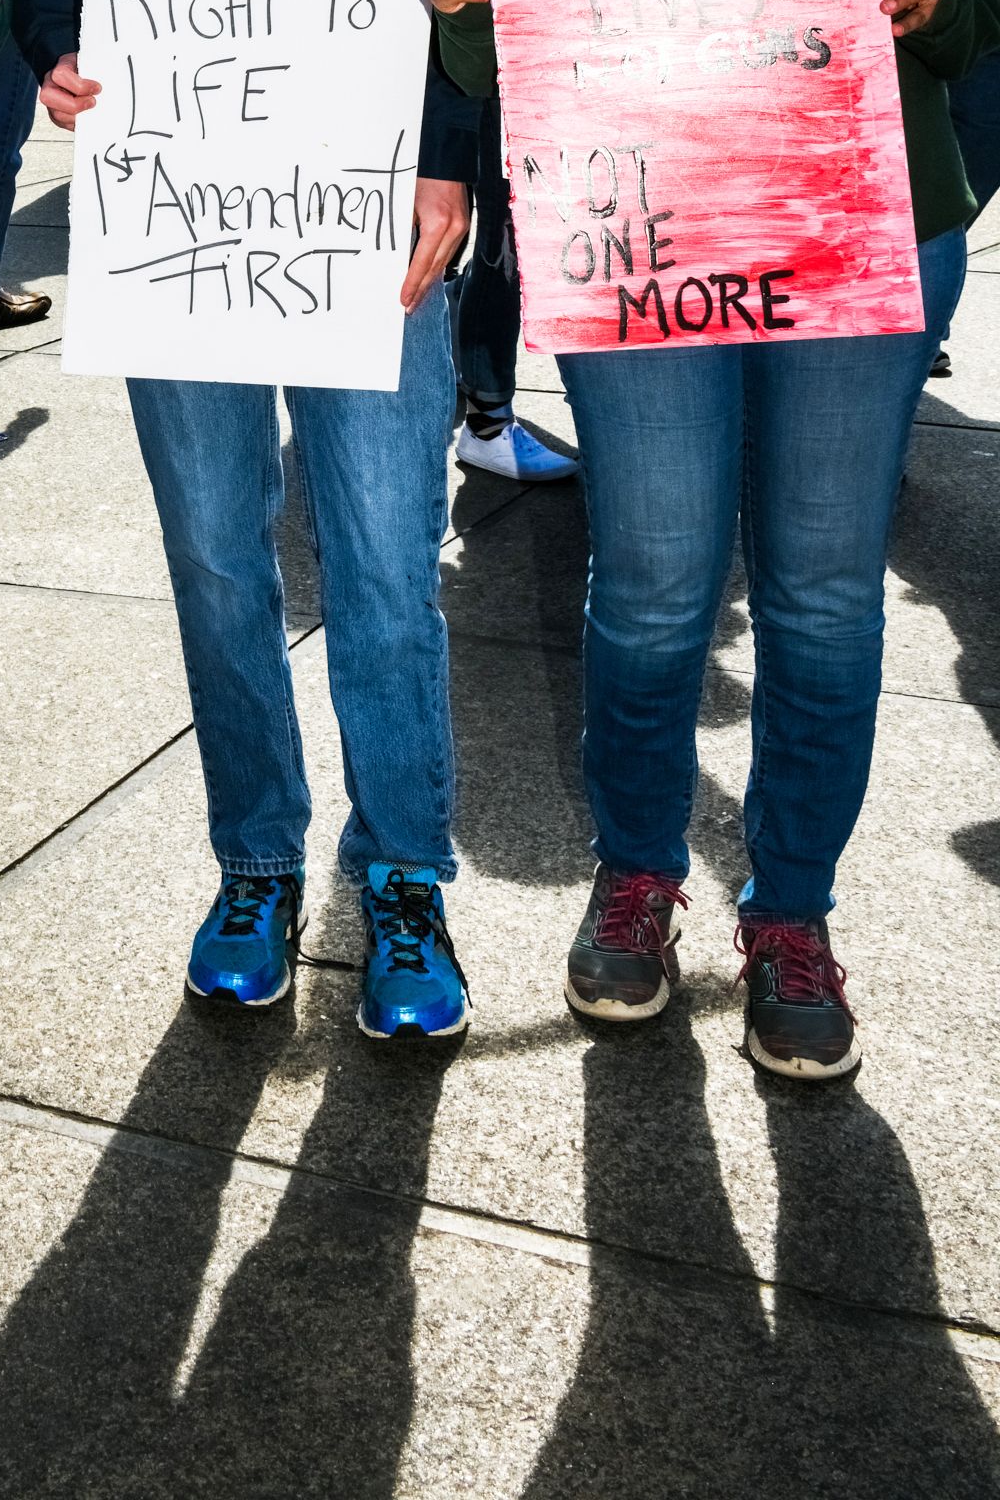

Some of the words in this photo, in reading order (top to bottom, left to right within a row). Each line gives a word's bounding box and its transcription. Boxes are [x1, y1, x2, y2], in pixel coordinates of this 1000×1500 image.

[93, 142, 146, 236] 1st
[146, 129, 417, 252] Amendment
[521, 141, 659, 227] NOT
[560, 210, 676, 286] ONE
[618, 271, 795, 342] MORE
